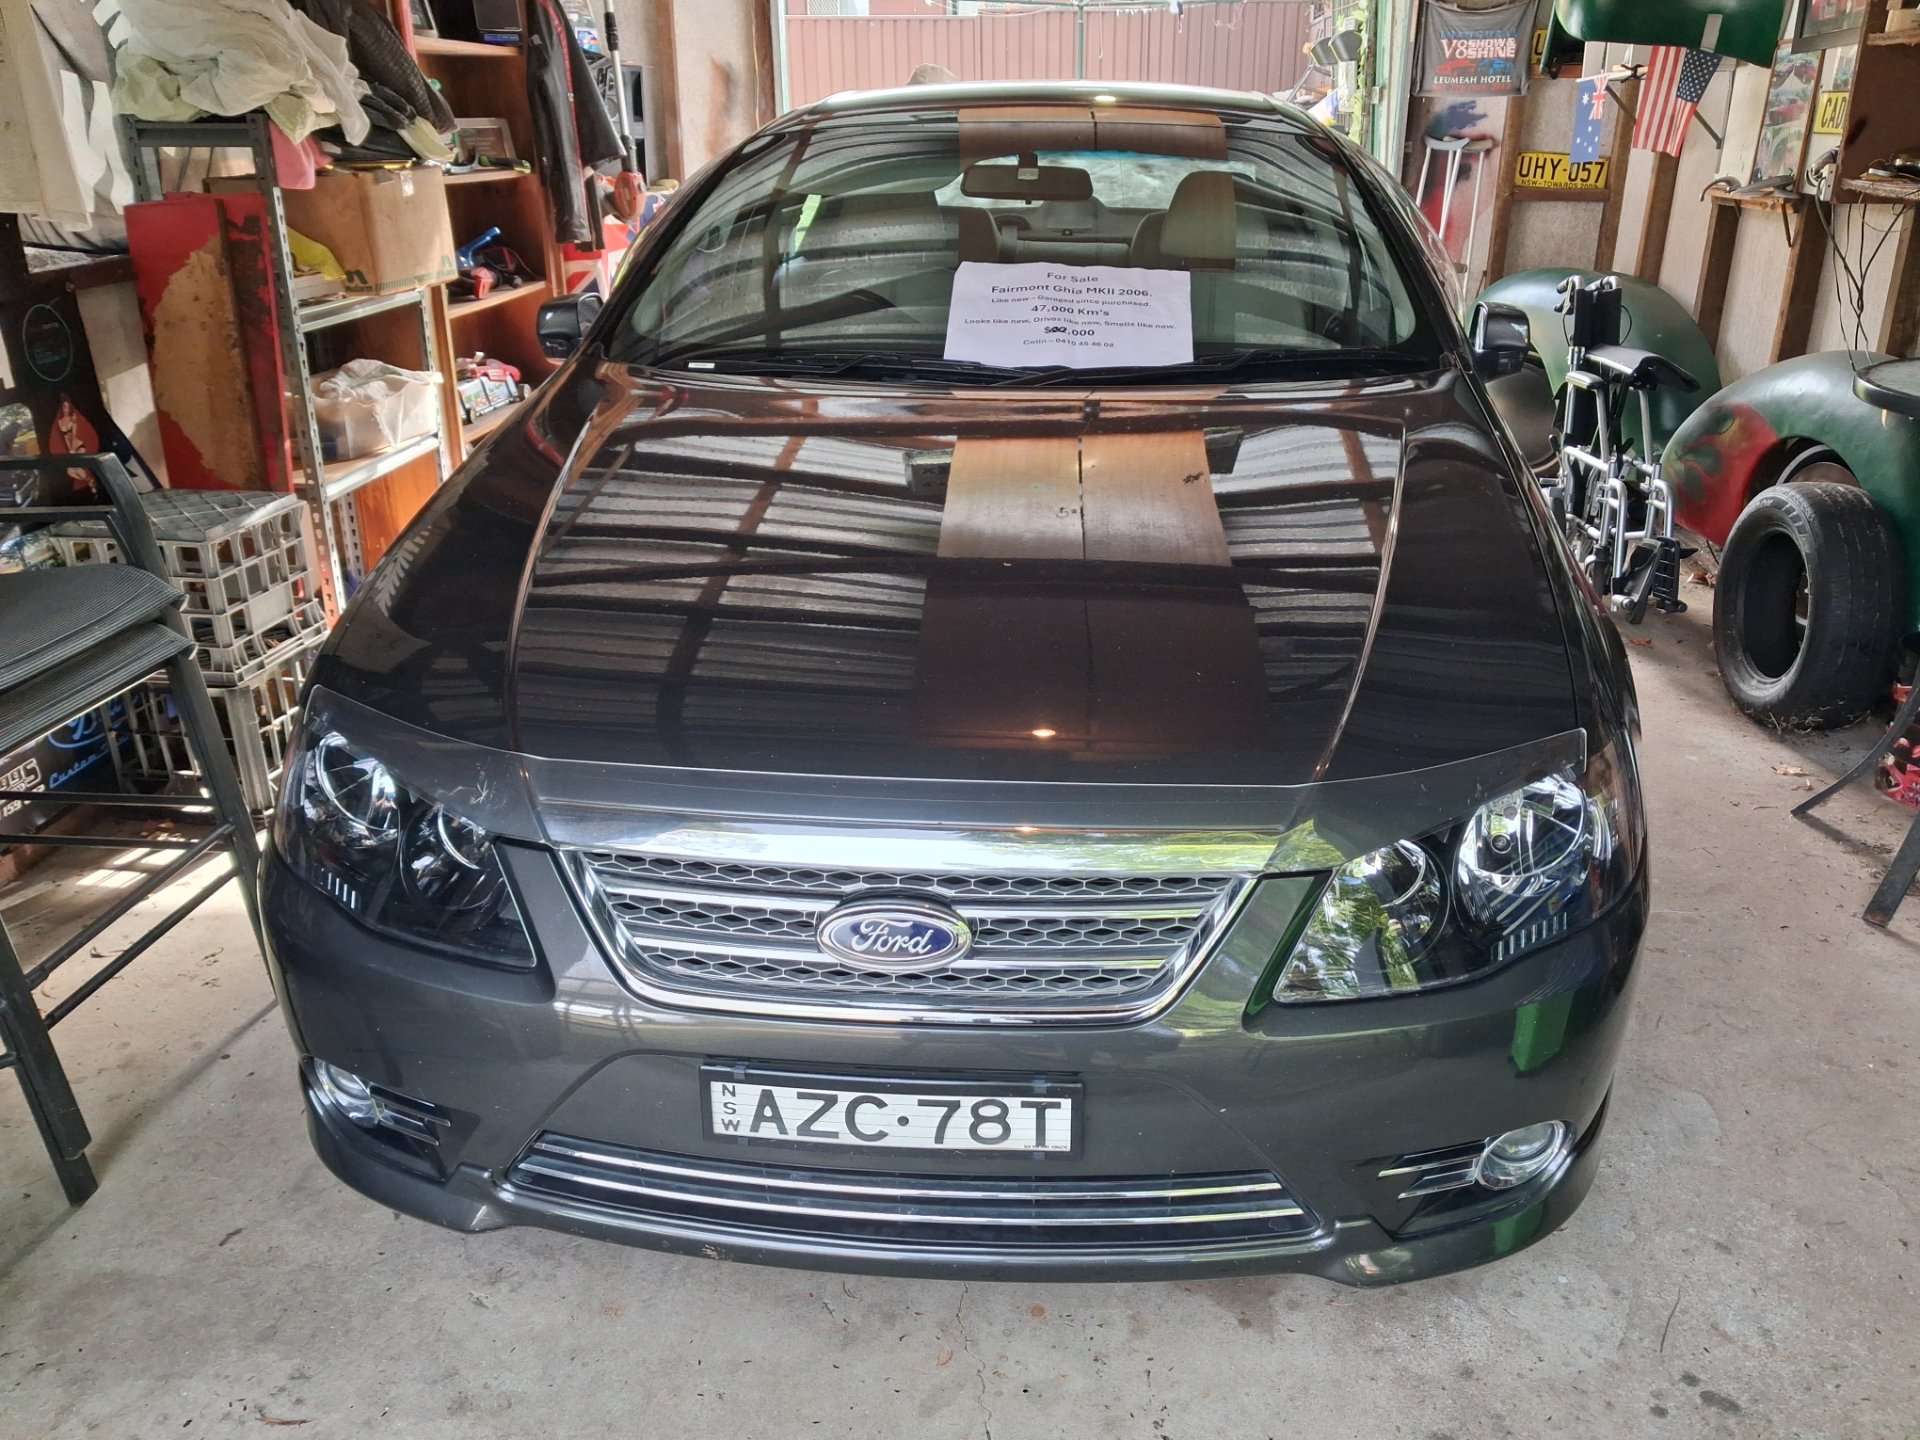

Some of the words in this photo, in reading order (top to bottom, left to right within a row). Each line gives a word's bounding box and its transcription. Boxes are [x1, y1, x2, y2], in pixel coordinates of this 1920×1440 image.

[1441, 39, 1468, 59] V8
[1467, 46, 1516, 59] SHINE
[1433, 75, 1478, 84] LEUMEAH
[1480, 74, 1512, 83] HOTEL
[1047, 272, 1068, 280] For
[1070, 275, 1099, 283] Sale
[991, 284, 1050, 294] Fairmont
[1053, 285, 1083, 295] Ghia
[1086, 287, 1115, 295] MKII
[1118, 288, 1153, 297] 2006.
[1077, 307, 1110, 316] Km's
[1063, 317, 1080, 326] like
[1104, 320, 1135, 328] Smells
[1137, 321, 1154, 329] like
[1055, 337, 1077, 347] 0410
[850, 917, 934, 955] Ford
